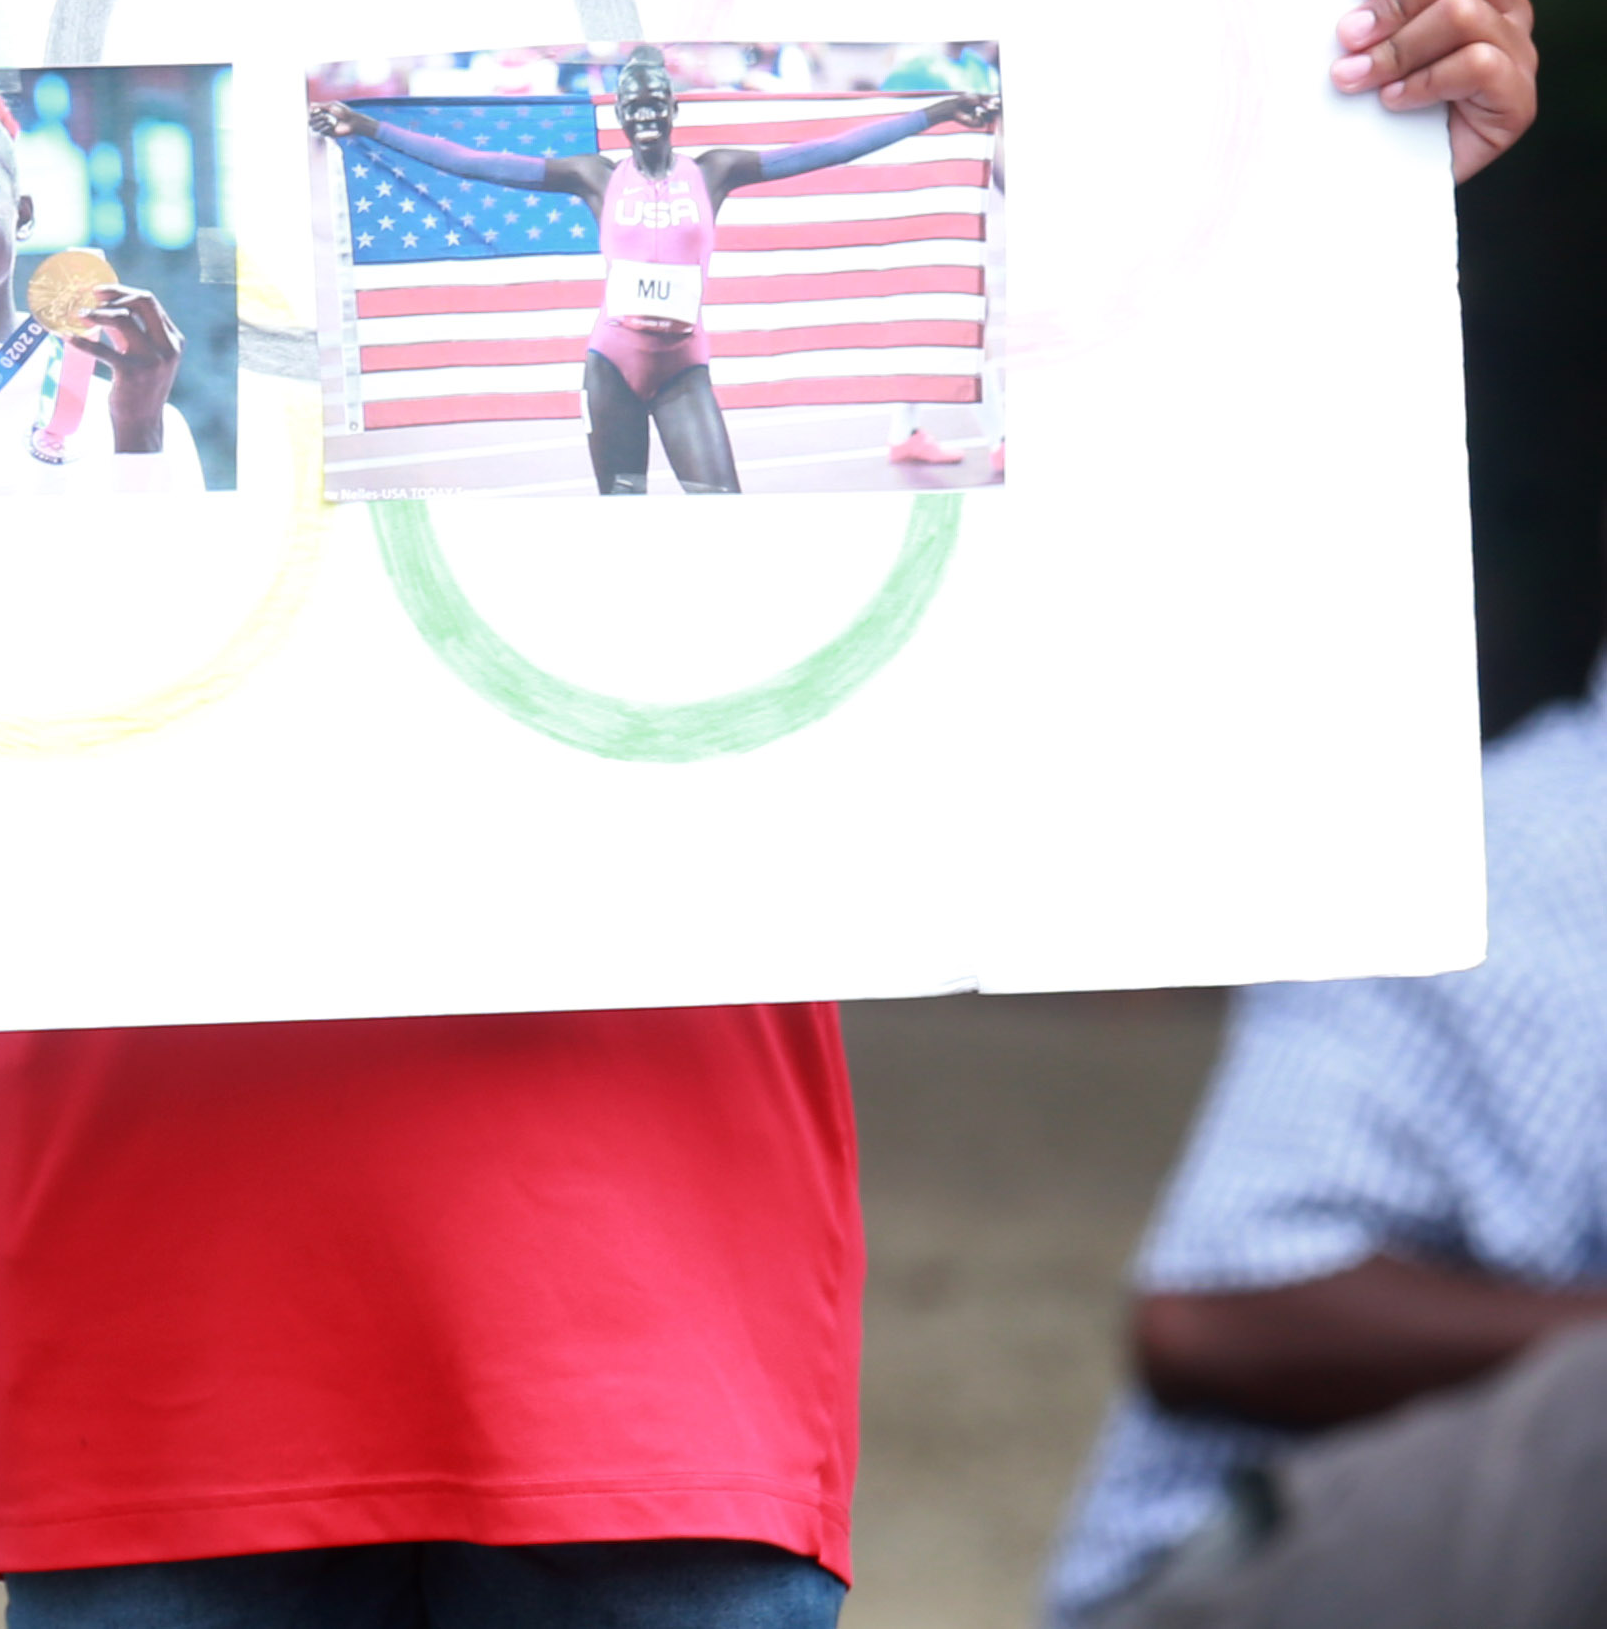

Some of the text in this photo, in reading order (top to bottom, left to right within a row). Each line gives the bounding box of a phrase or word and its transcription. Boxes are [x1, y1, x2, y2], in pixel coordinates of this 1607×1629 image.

[614, 198, 700, 229] USA
[637, 278, 671, 300] MU
[0, 332, 34, 369] 2020
